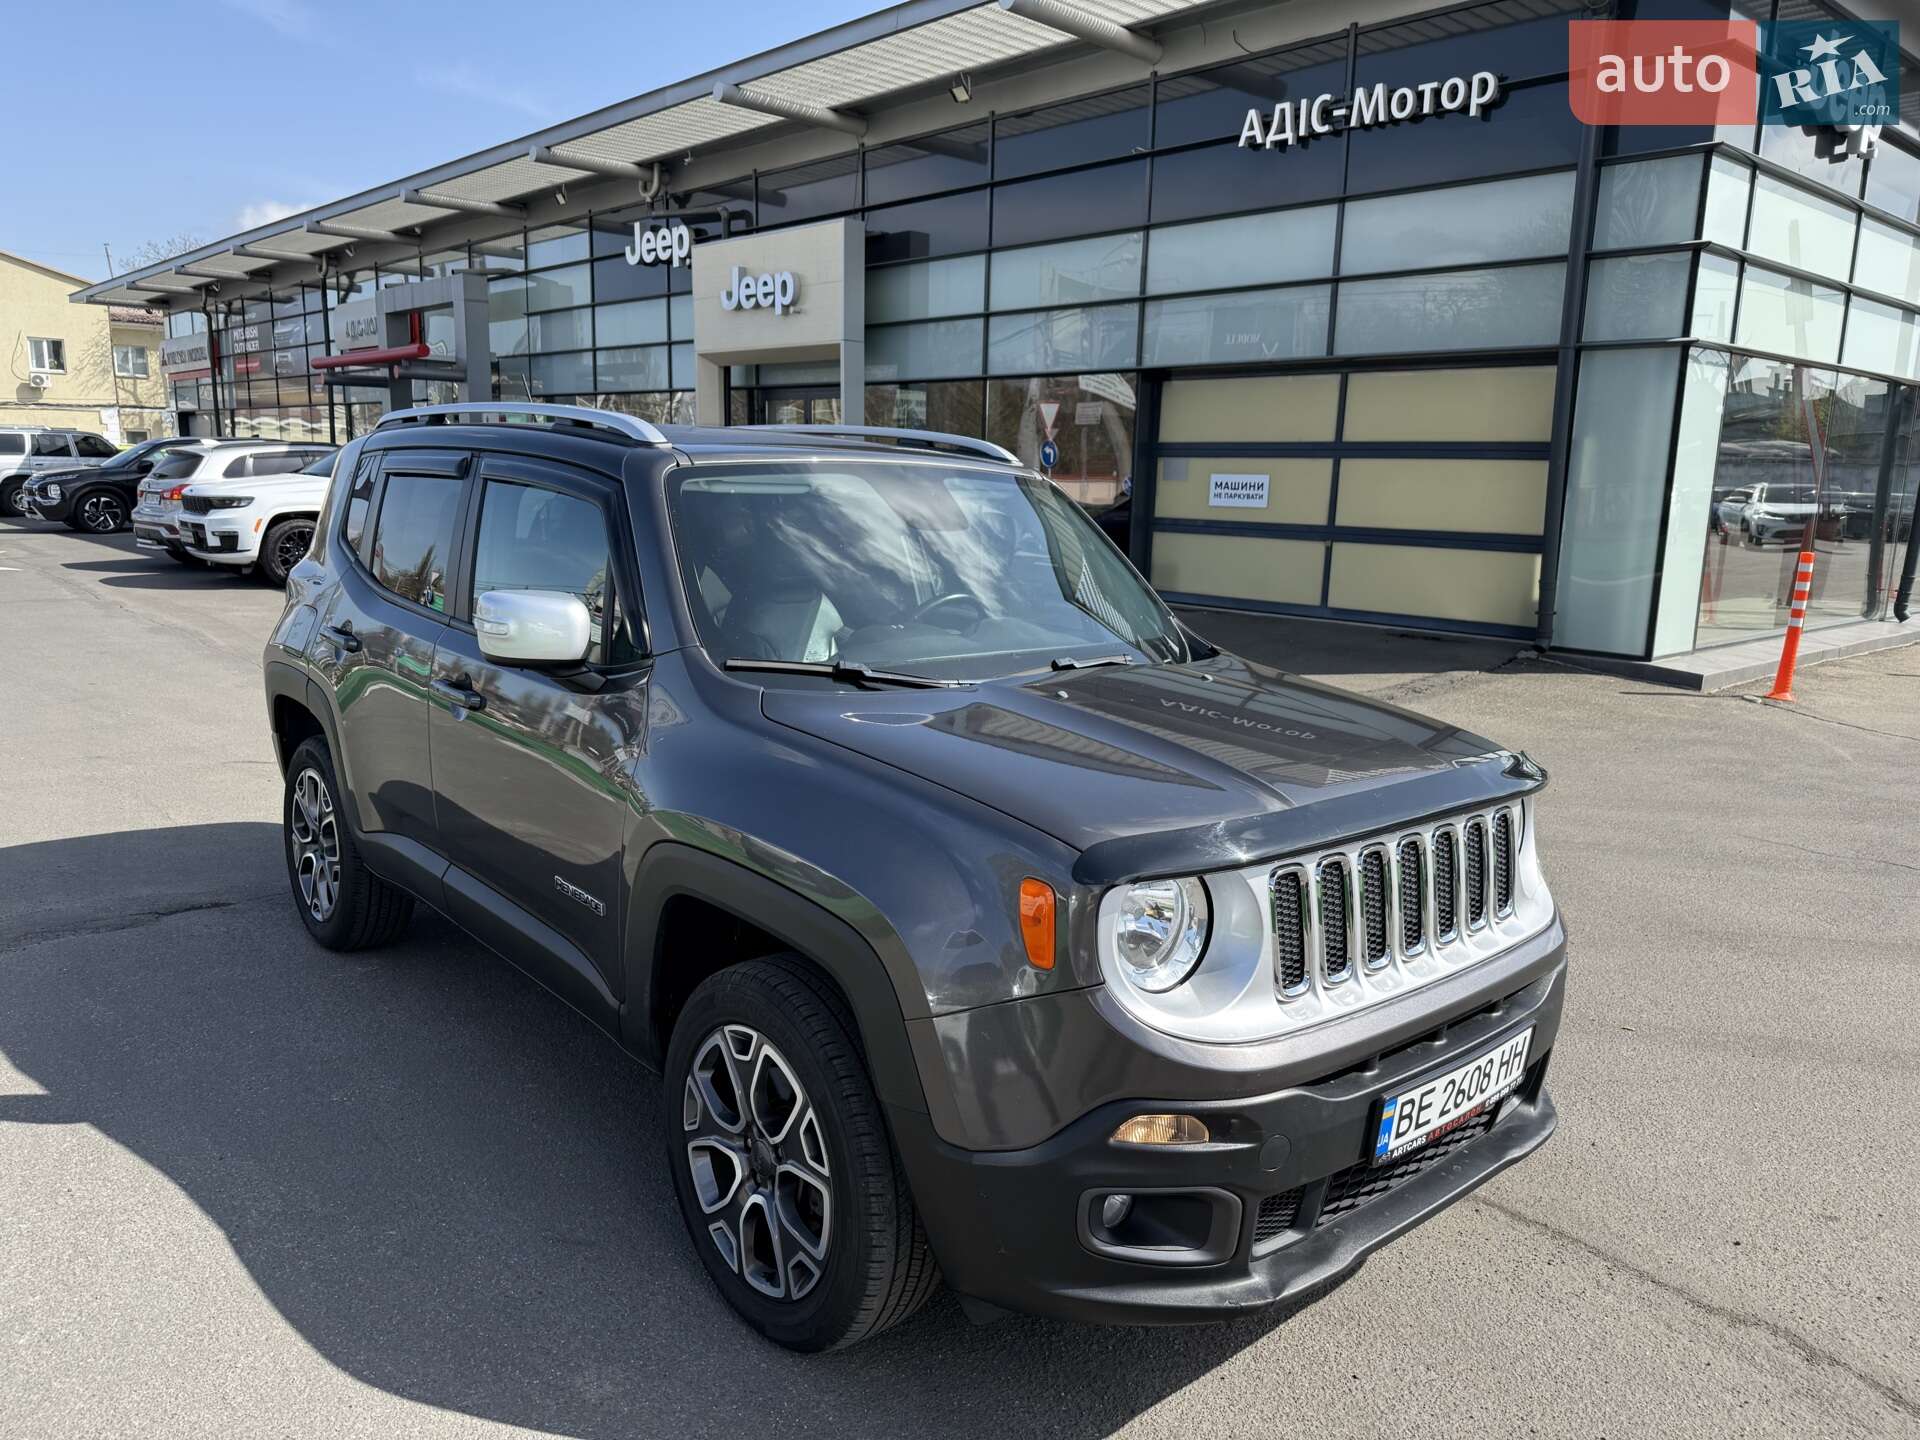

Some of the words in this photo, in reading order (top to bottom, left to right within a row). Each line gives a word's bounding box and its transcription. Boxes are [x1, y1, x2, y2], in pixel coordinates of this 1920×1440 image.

[1238, 71, 1500, 149] АДІС-Мотор
[1214, 481, 1264, 491] МАШИНИ
[1224, 492, 1264, 500] ПАРКУВАТИ
[1394, 1086, 1437, 1140] BE
[1438, 1057, 1494, 1118] 2608
[1495, 1035, 1528, 1086] HH
[1392, 1135, 1427, 1158] ARTCARS
